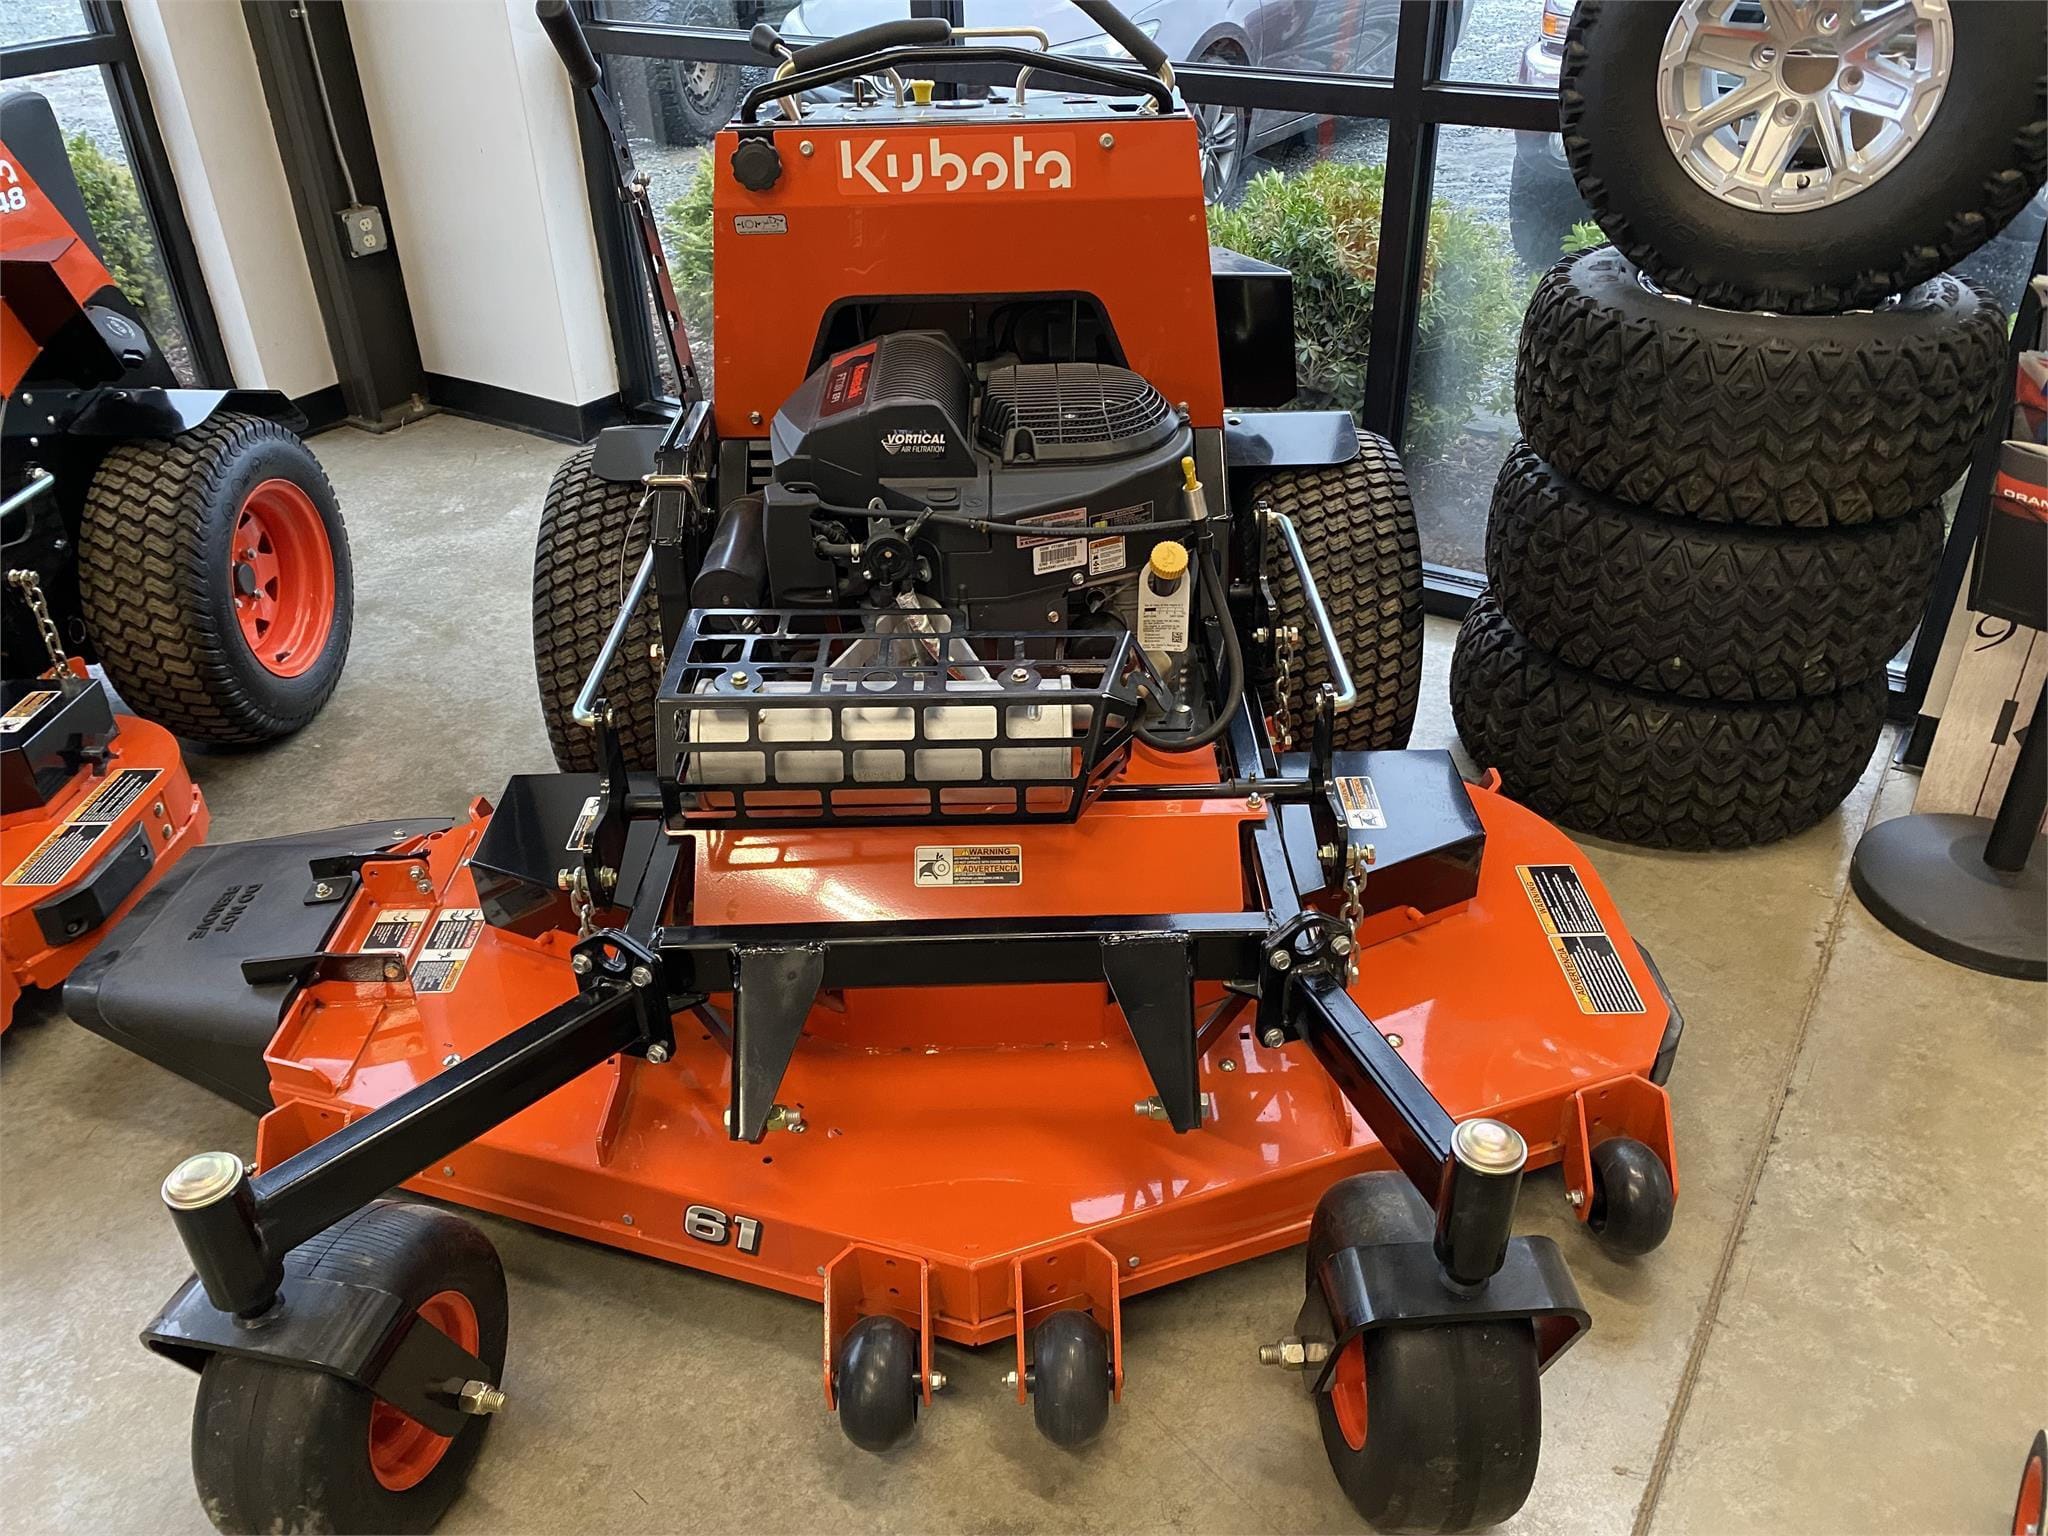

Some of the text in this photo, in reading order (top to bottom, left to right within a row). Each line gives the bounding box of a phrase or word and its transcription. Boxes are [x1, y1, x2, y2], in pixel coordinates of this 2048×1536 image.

[840, 136, 1072, 192] Kubota
[887, 433, 946, 444] VORTICAL
[900, 445, 945, 453] AIR FILTRATION
[820, 670, 938, 692] HOT
[963, 864, 1018, 873] ADVERTENCIA
[969, 848, 1011, 856] WARNING
[187, 885, 242, 941] REMOVE
[215, 884, 264, 933] DO NOT
[1526, 881, 1547, 914] WARNING
[1557, 947, 1587, 996] ADVERTENCIA
[684, 1204, 761, 1254] 61
